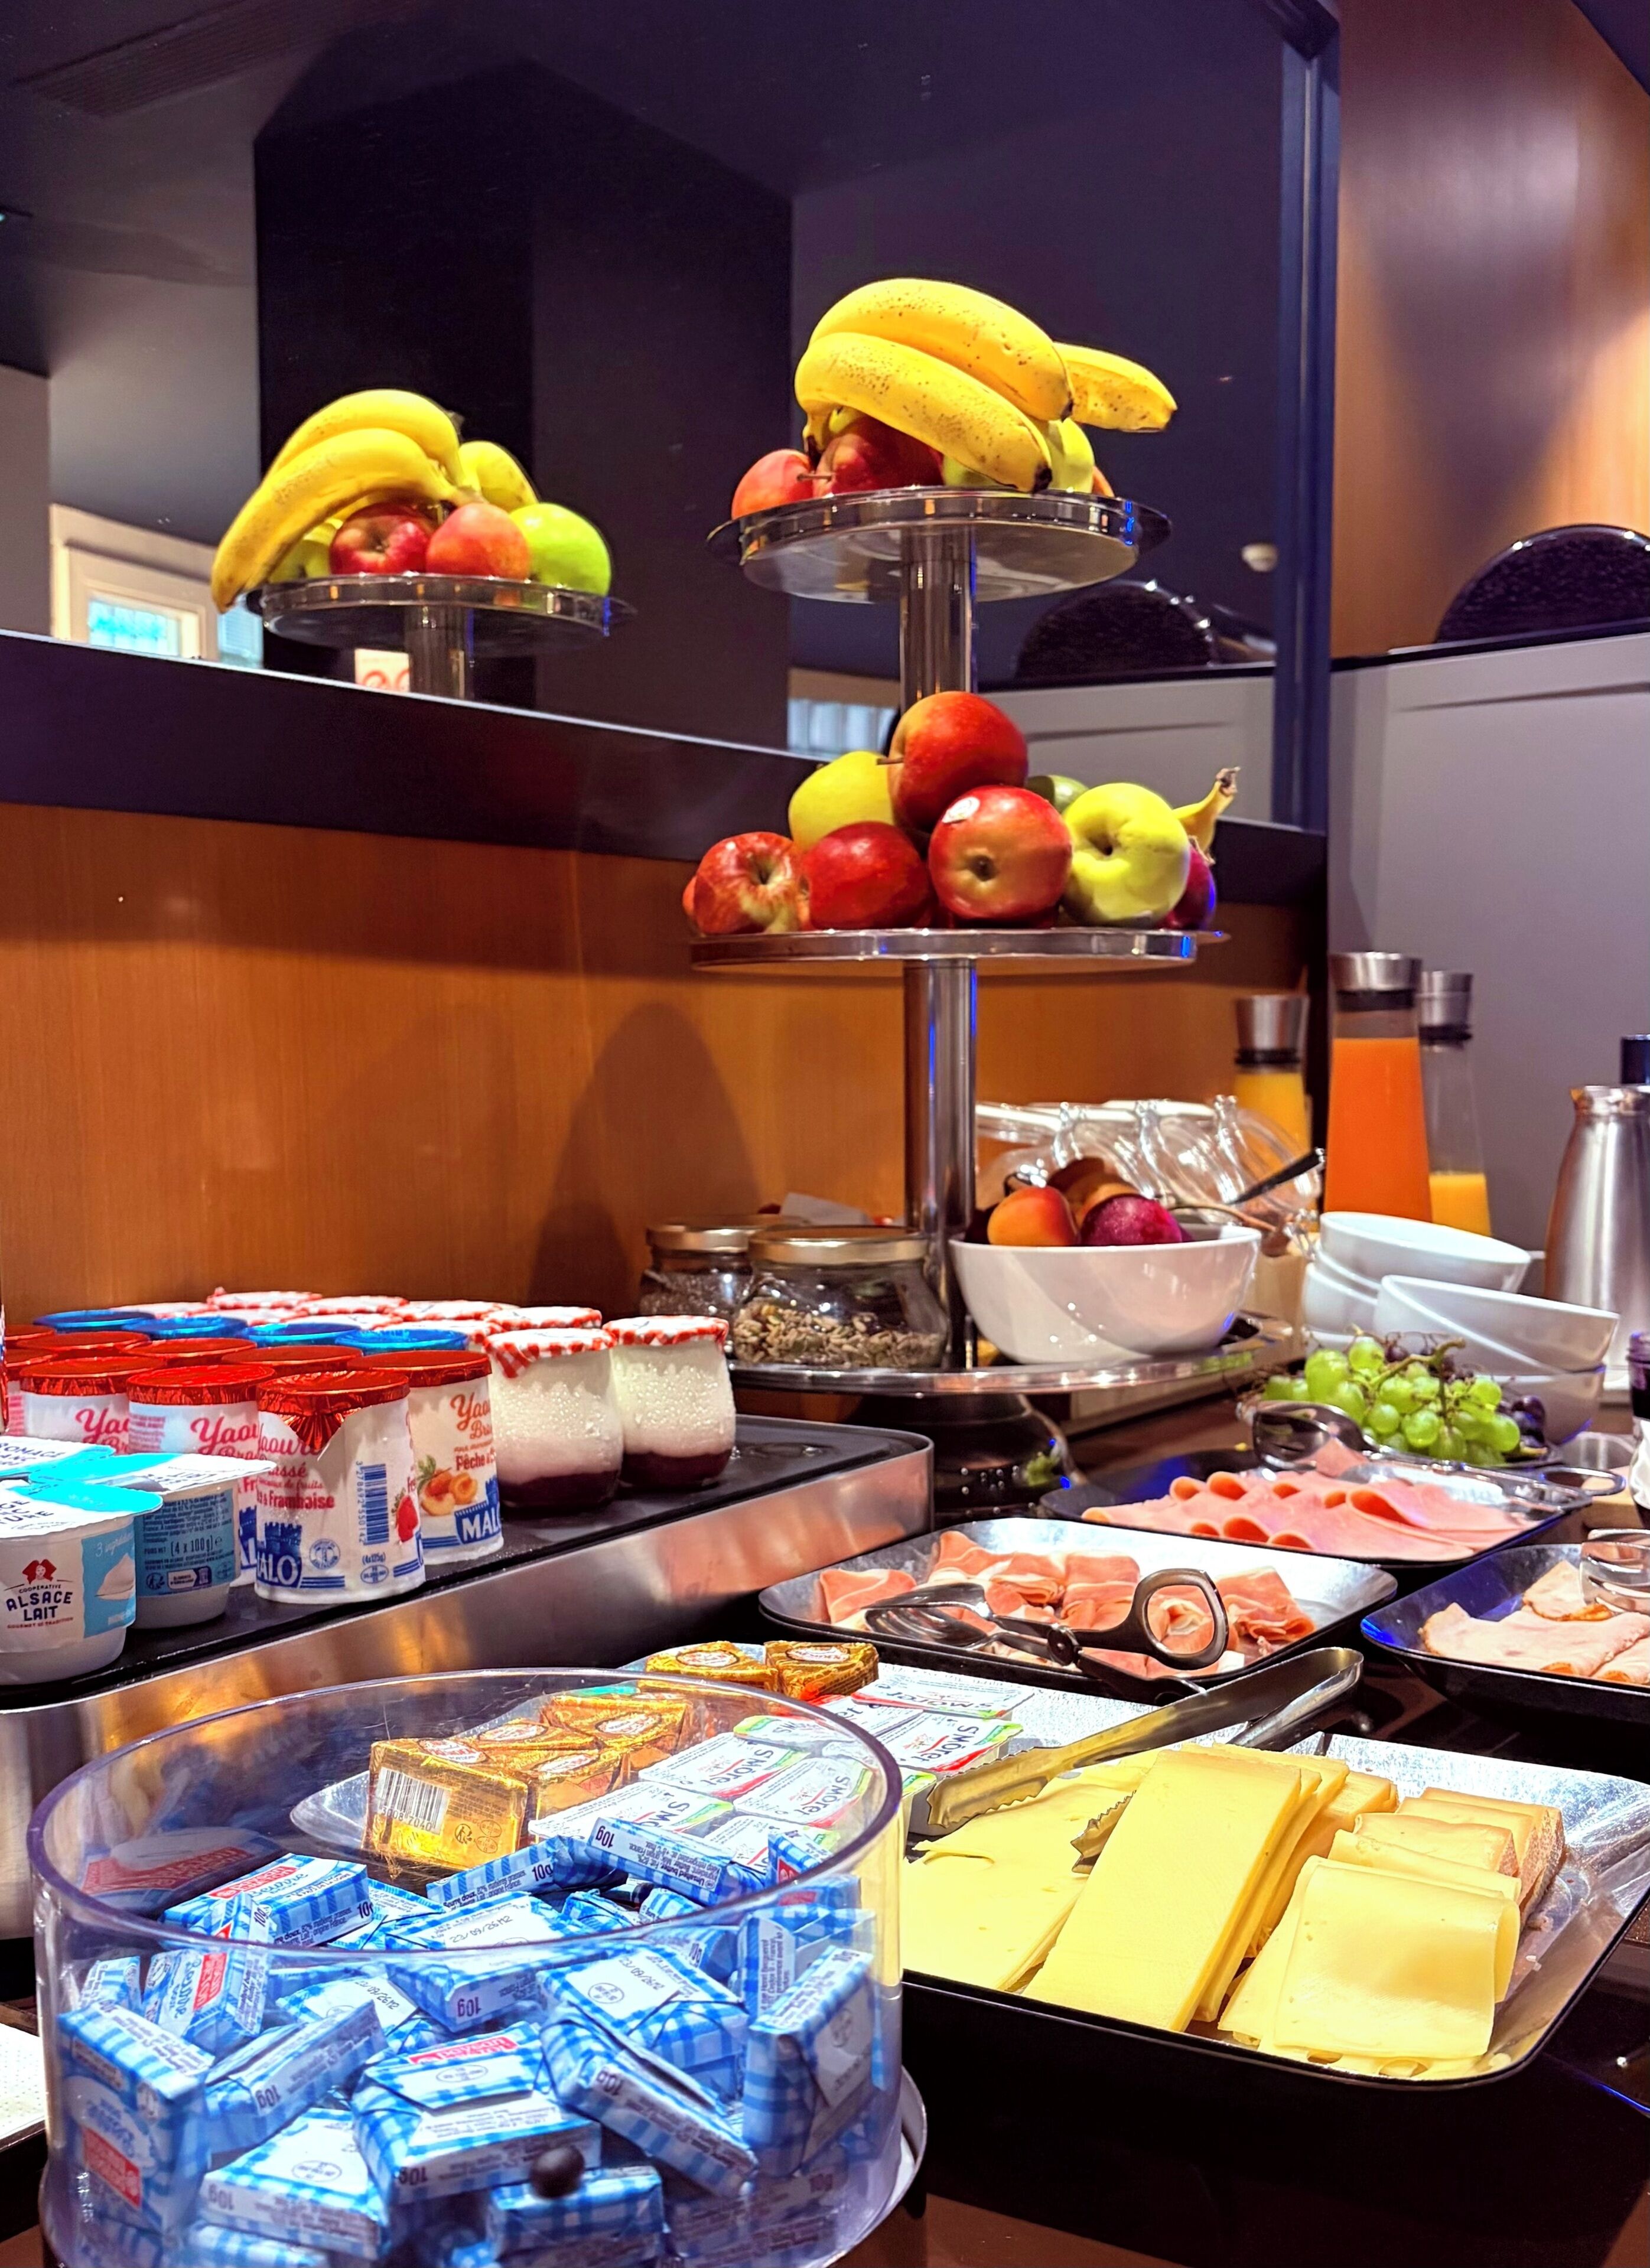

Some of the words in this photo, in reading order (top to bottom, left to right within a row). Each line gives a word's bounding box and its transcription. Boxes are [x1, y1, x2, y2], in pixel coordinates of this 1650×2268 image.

[6, 1591, 73, 1611] ALSACE
[24, 1605, 58, 1621] LAIT
[408, 1815, 432, 1832] 7040
[595, 1825, 616, 1848] 10g
[457, 1996, 482, 2018] 10g
